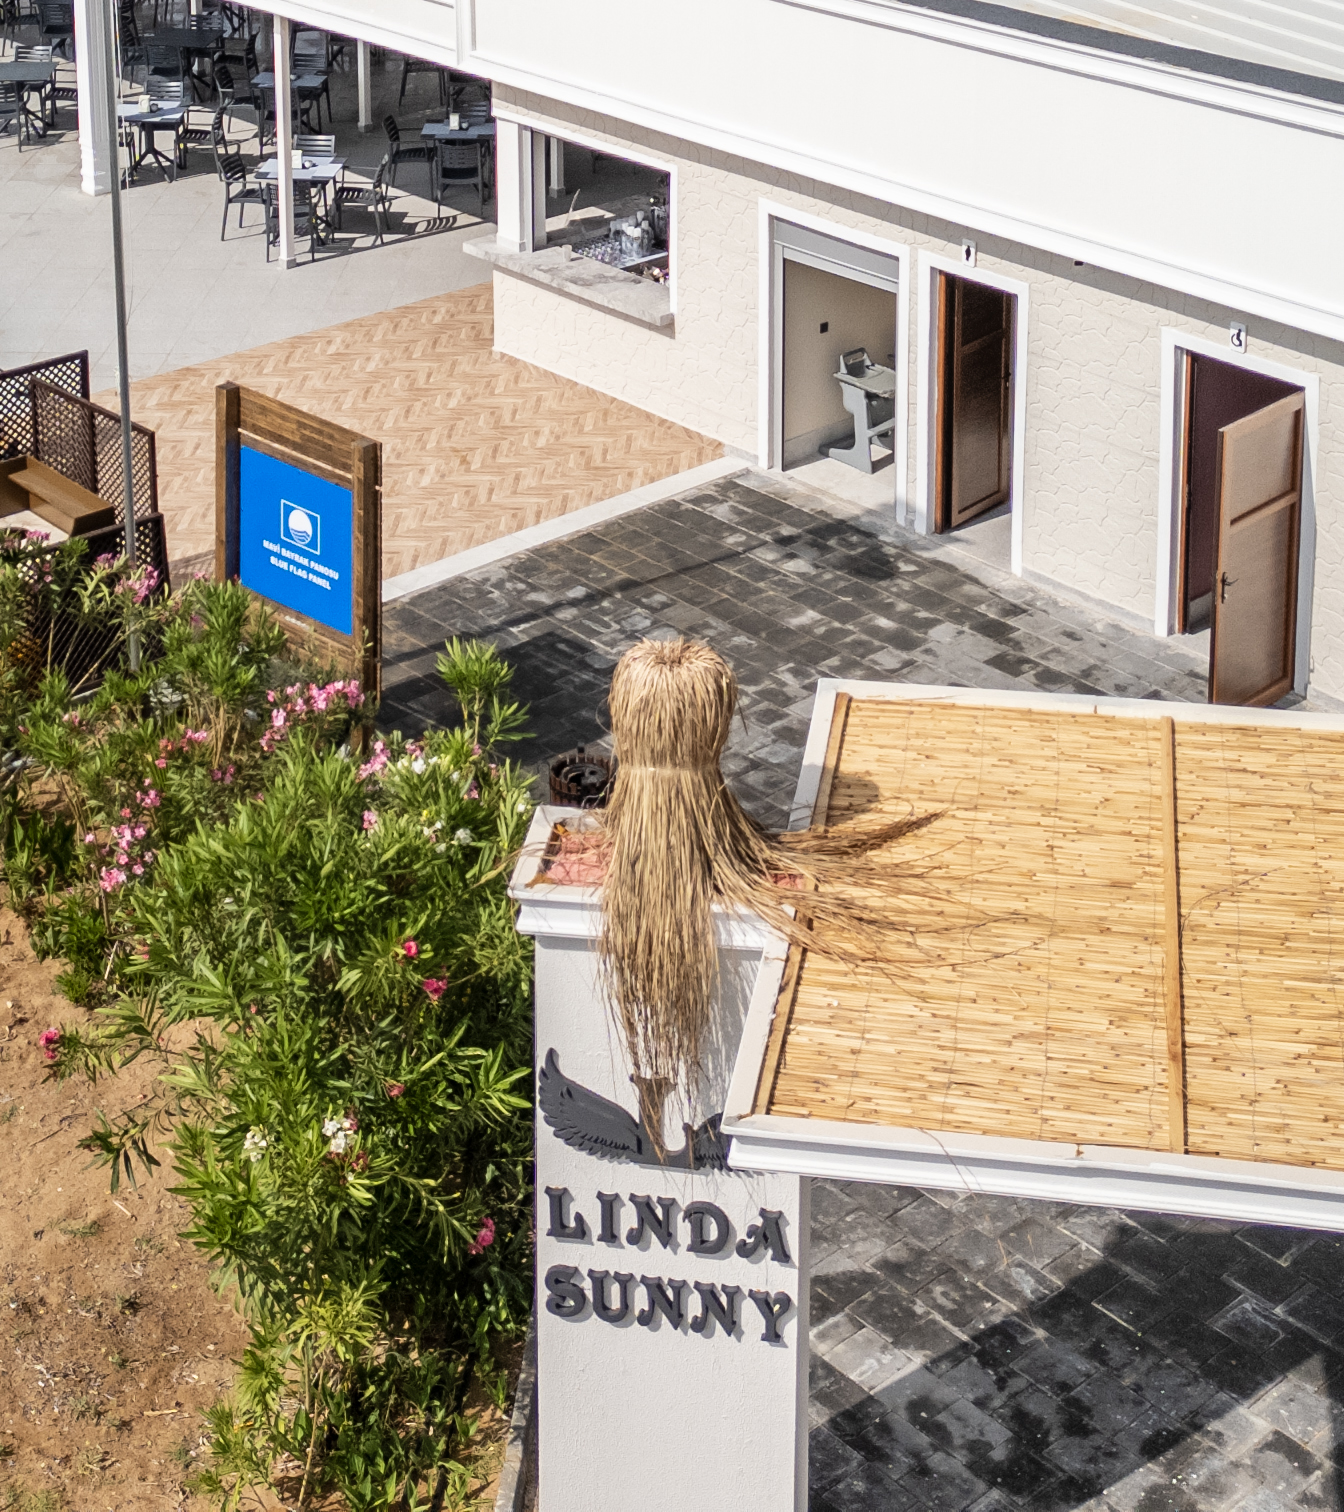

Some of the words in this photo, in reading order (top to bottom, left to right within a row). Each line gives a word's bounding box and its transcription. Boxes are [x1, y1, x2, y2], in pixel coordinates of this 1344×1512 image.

[270, 555, 288, 571] BLUE
[289, 564, 308, 579] FLAG
[308, 572, 331, 590] PANEL
[544, 1185, 790, 1263] LINDA
[544, 1264, 792, 1343] SUNNY
